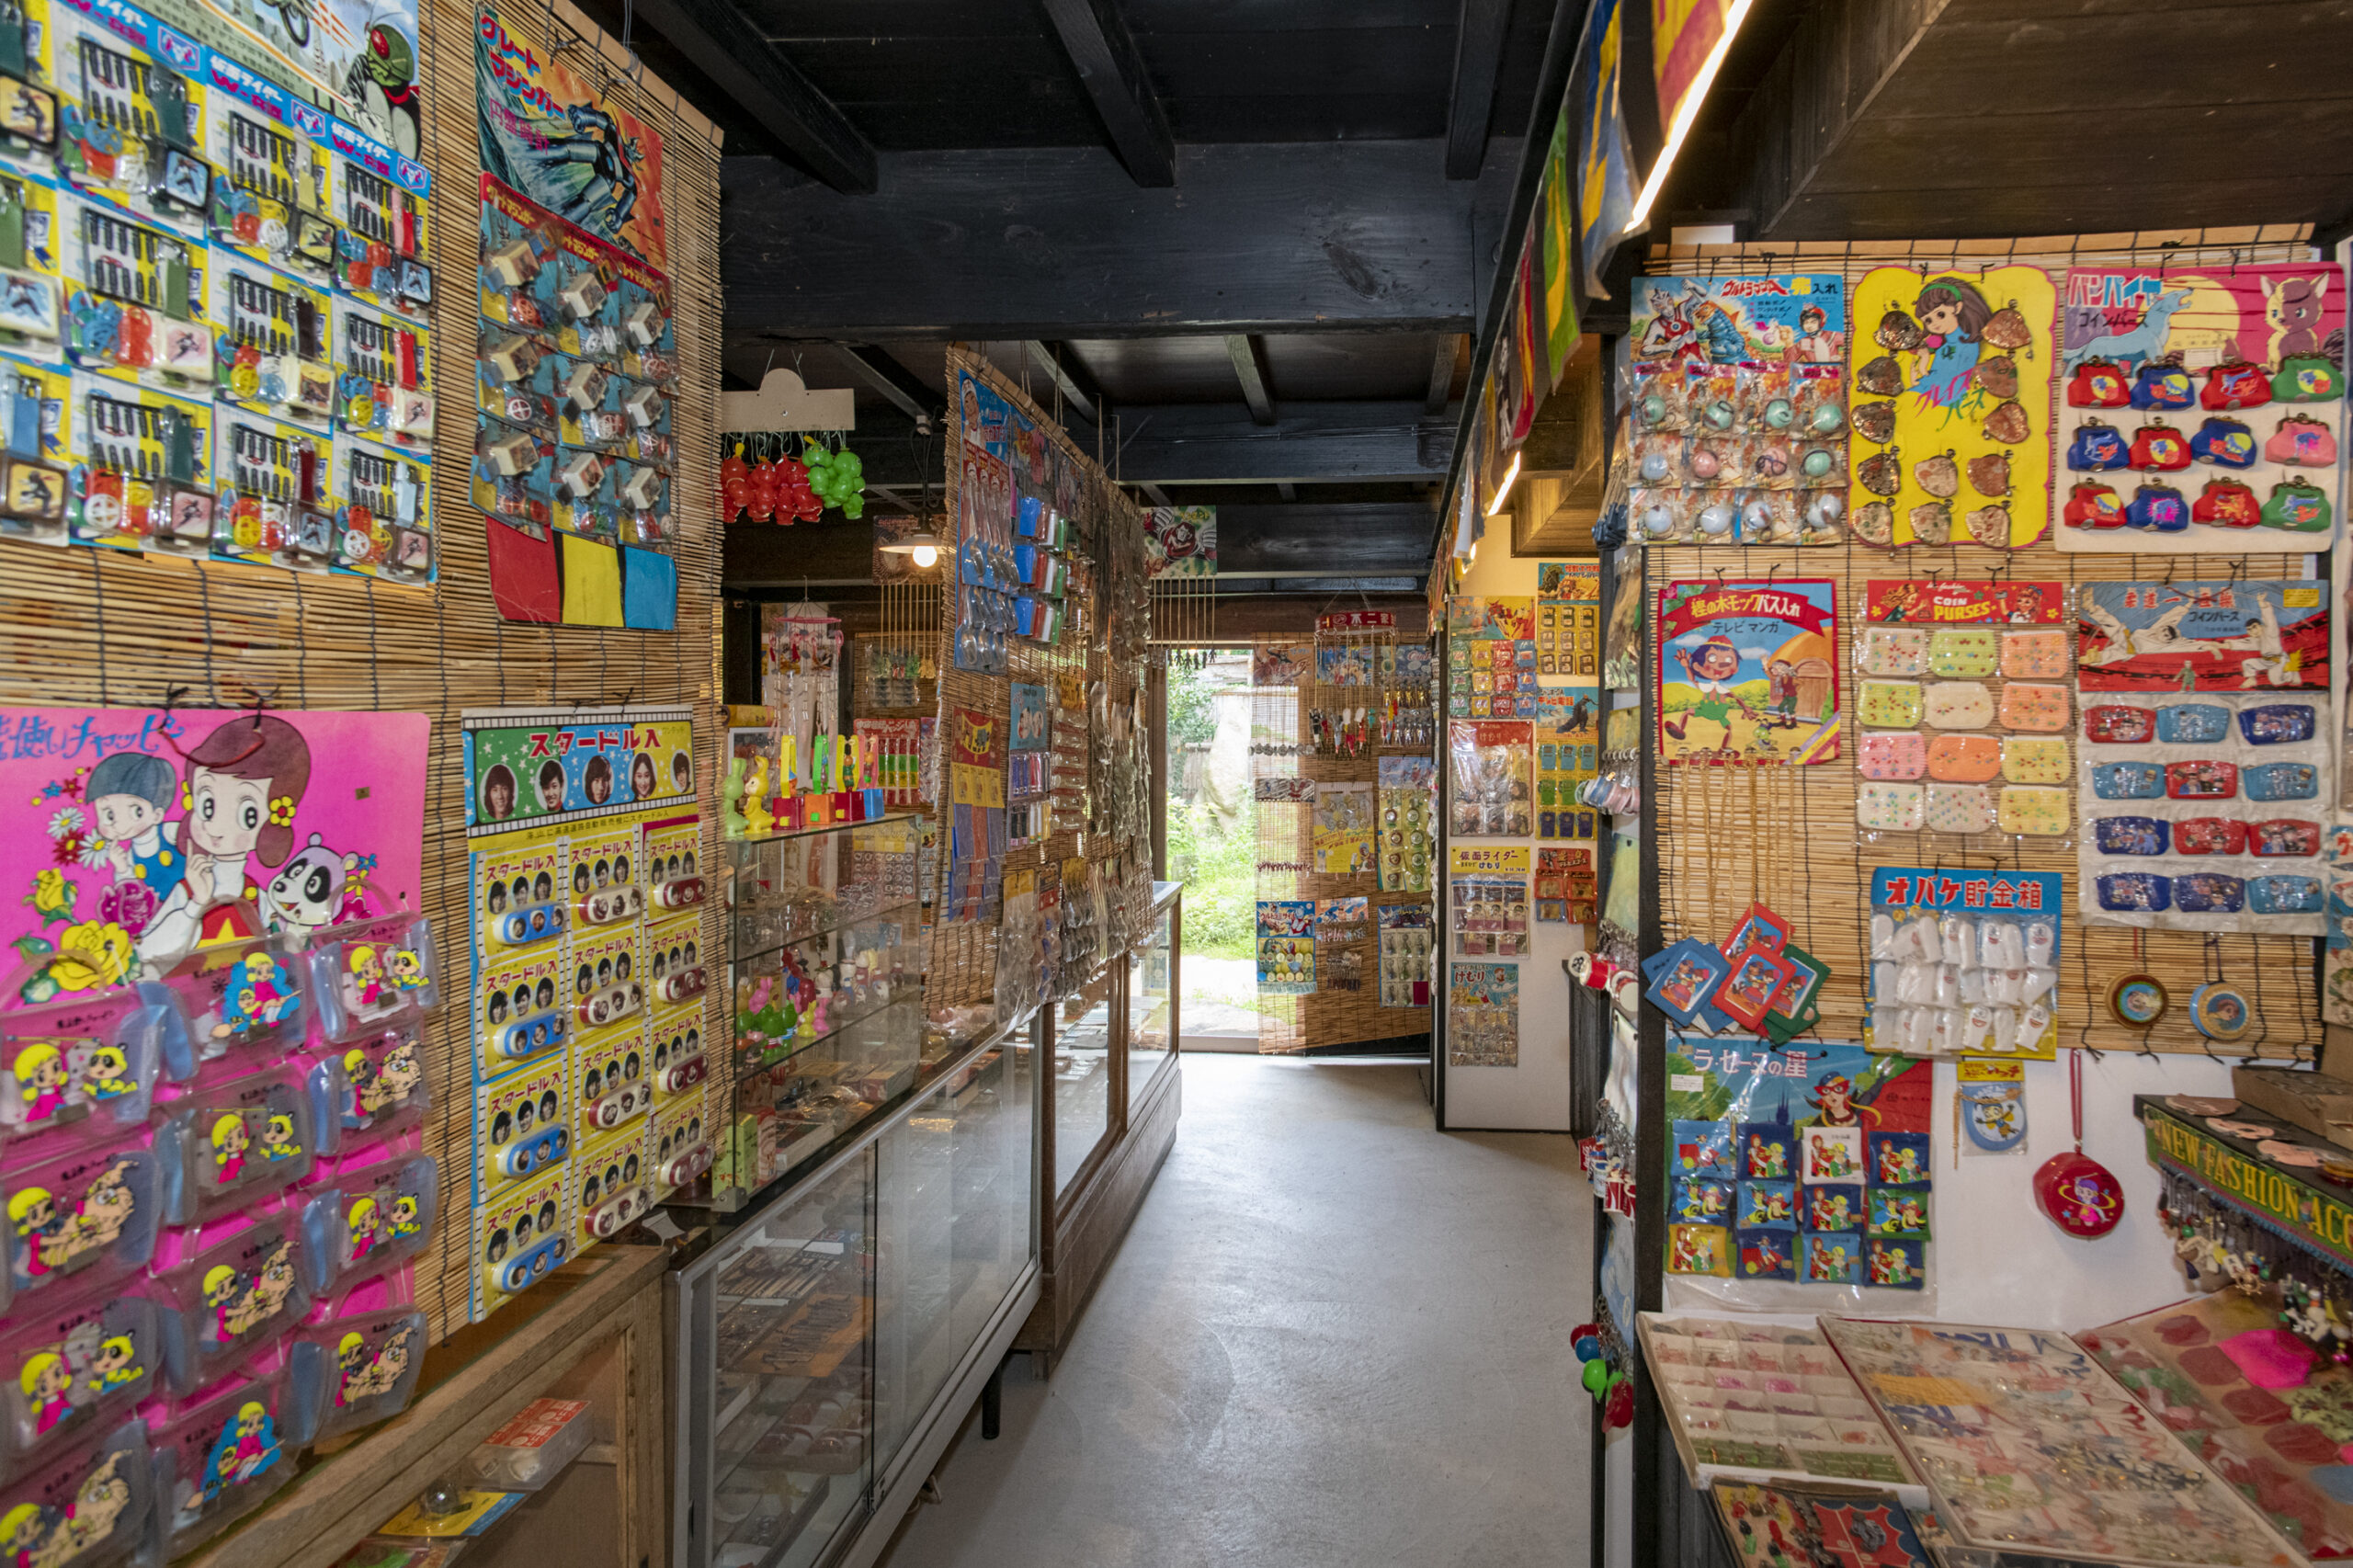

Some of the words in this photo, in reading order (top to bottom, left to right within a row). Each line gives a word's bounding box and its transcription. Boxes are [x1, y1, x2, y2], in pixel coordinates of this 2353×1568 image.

[481, 15, 541, 77] グレート
[489, 51, 566, 119] マジンガー
[1934, 596, 1968, 606] COIN
[1934, 601, 1991, 620] PURSES
[529, 729, 662, 758] スタードル入
[485, 851, 557, 882] スタードル入
[571, 840, 632, 864] スタードル入
[1460, 850, 1519, 860] 仮面ライダー
[1885, 876, 2042, 910] オバケ貯金箱
[574, 936, 634, 966] スタードル入
[485, 958, 557, 994] スタードル入
[1455, 971, 1485, 983] けむり
[583, 1036, 644, 1073] スタードル入
[490, 1072, 562, 1116] スタードル入
[582, 1137, 643, 1179] スタードル入
[2161, 1120, 2200, 1168] NEW
[2202, 1142, 2301, 1222] FASHION
[485, 1182, 561, 1234] スタードル入
